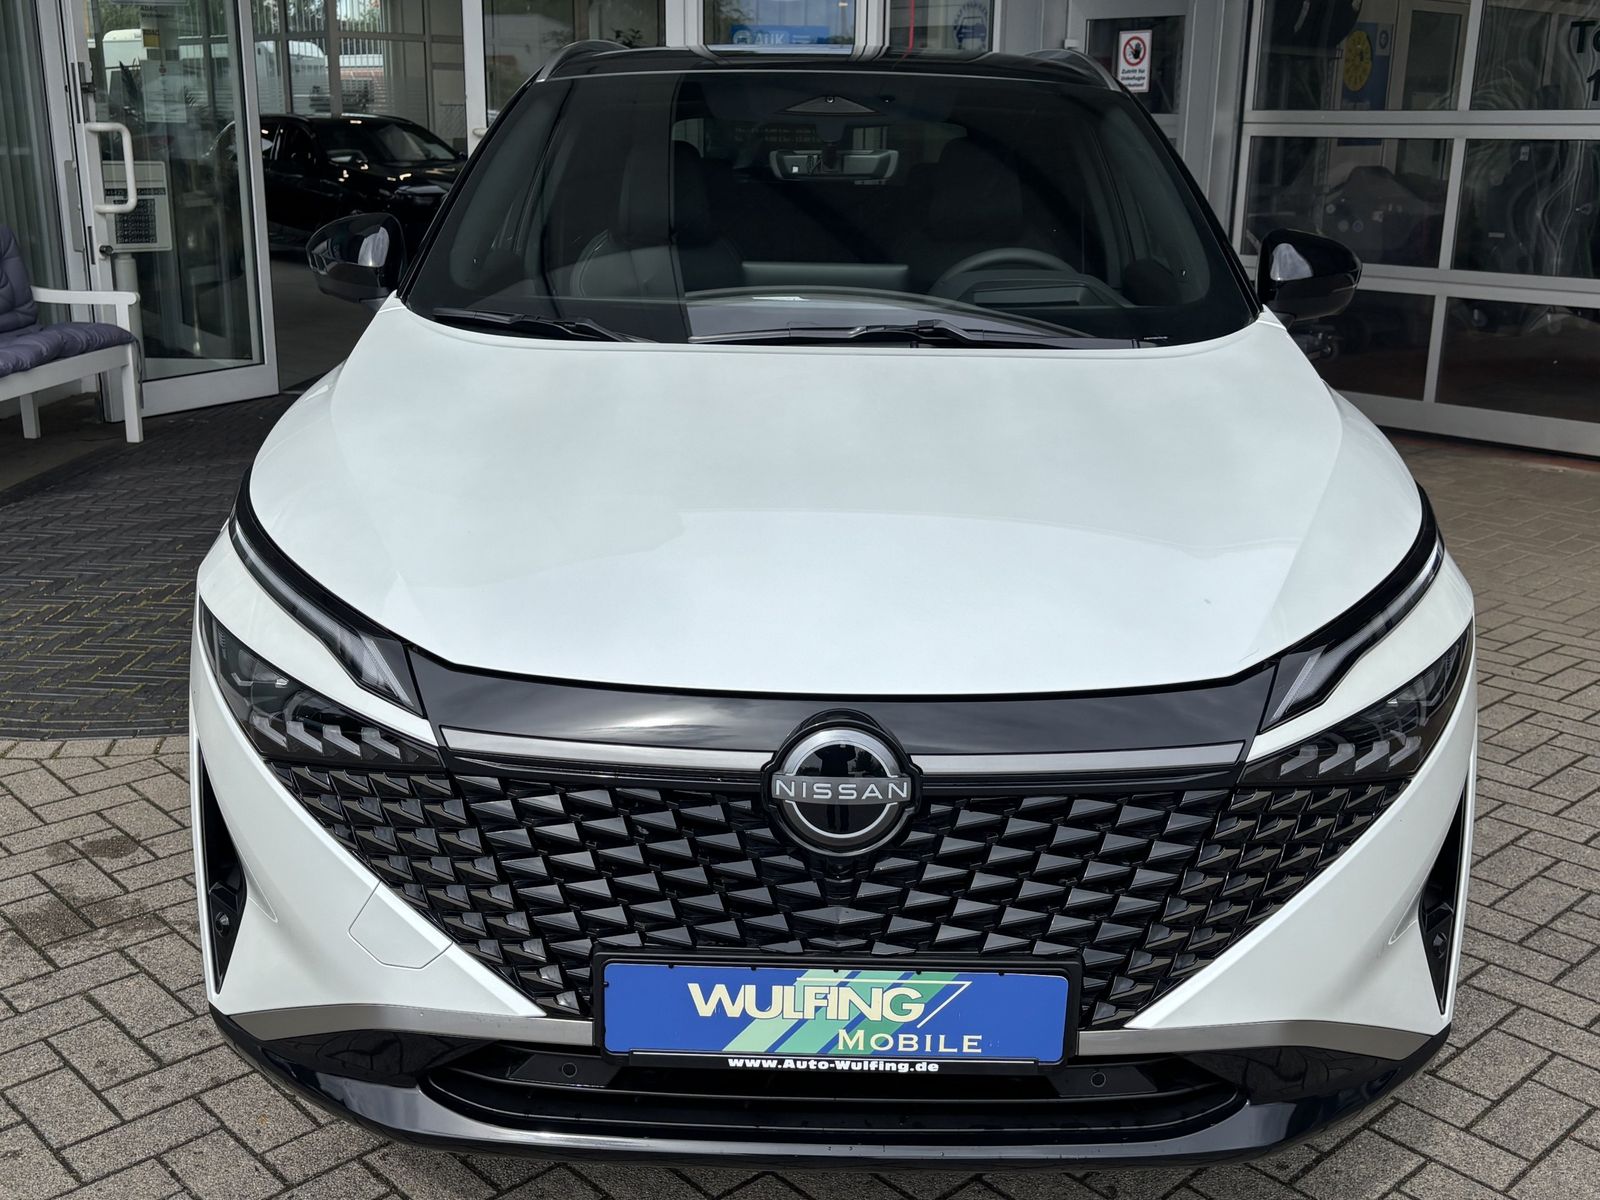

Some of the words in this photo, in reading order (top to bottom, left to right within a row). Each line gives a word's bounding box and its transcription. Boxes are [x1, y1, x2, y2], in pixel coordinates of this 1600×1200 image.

[775, 780, 908, 800] NISSAN
[687, 982, 926, 1023] WULFING
[837, 1029, 983, 1053] MOBILE
[727, 1058, 940, 1072] www.Auto-Wulfing.de
